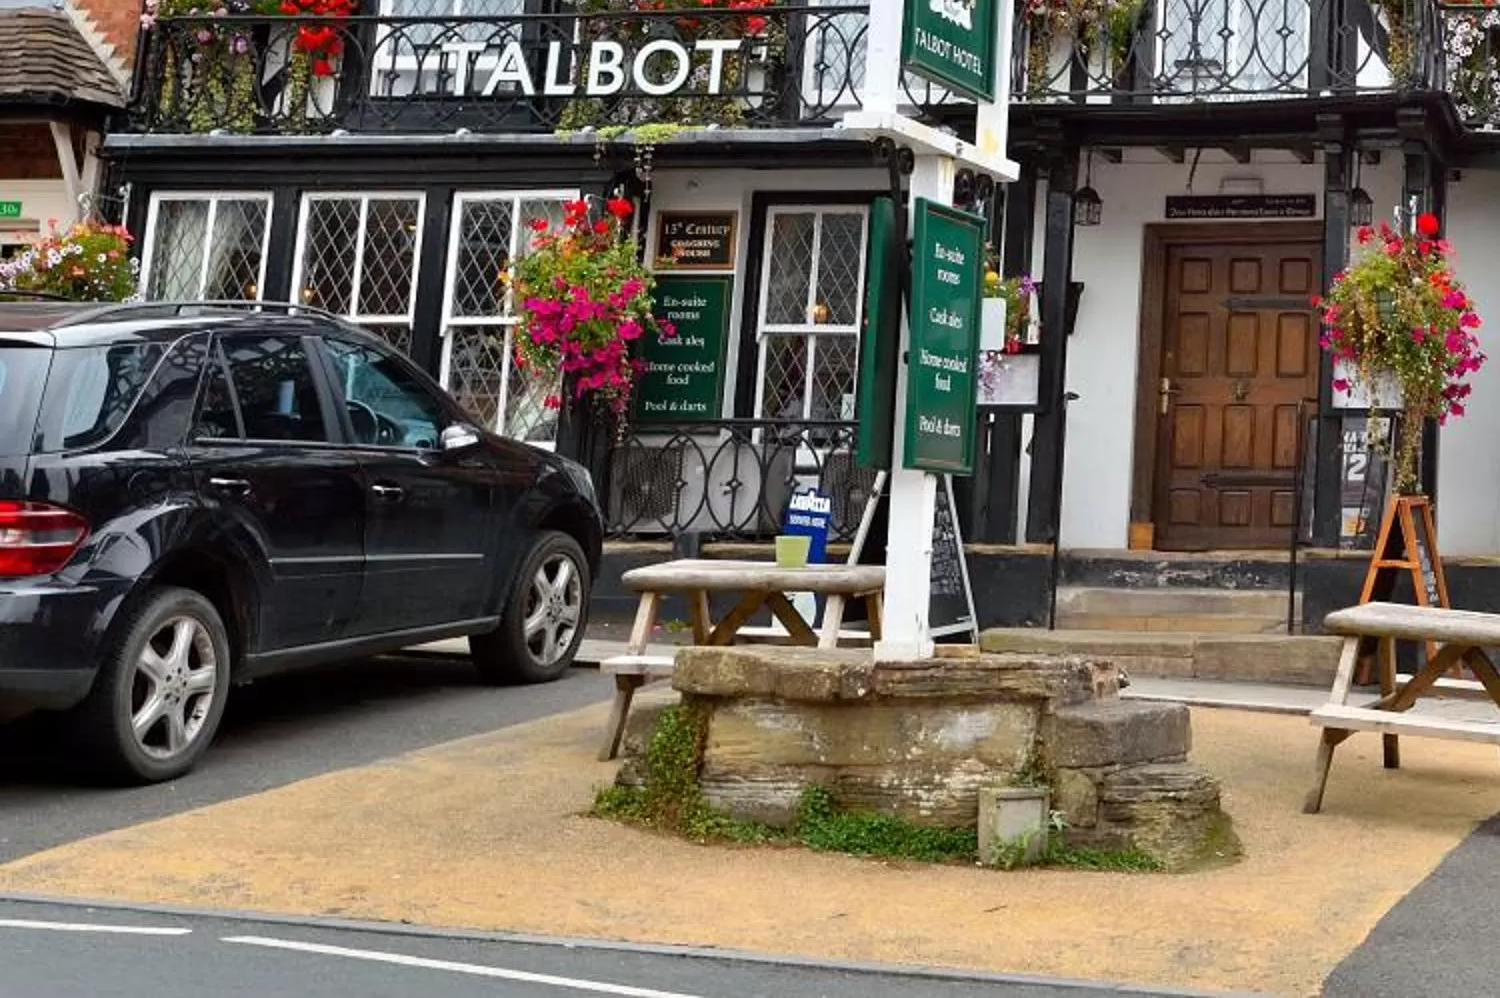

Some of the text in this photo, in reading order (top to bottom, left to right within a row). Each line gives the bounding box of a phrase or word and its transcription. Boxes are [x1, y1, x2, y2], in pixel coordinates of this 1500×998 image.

[915, 28, 982, 77] TALBOT HOTEL
[442, 40, 742, 96] TALBOT
[685, 223, 731, 236] Century
[934, 242, 965, 265] En-suite
[937, 269, 961, 285] rooms
[663, 292, 707, 307] En-suite
[668, 310, 700, 320] rooms
[929, 306, 963, 329] Cask ales
[657, 334, 682, 345] Cask
[677, 361, 715, 373] cooked
[920, 348, 968, 373] Home cooked
[666, 373, 690, 385] food
[936, 372, 951, 392] food
[645, 400, 707, 412] Pool & darts
[920, 415, 936, 433] Pool
[943, 417, 960, 437] darts
